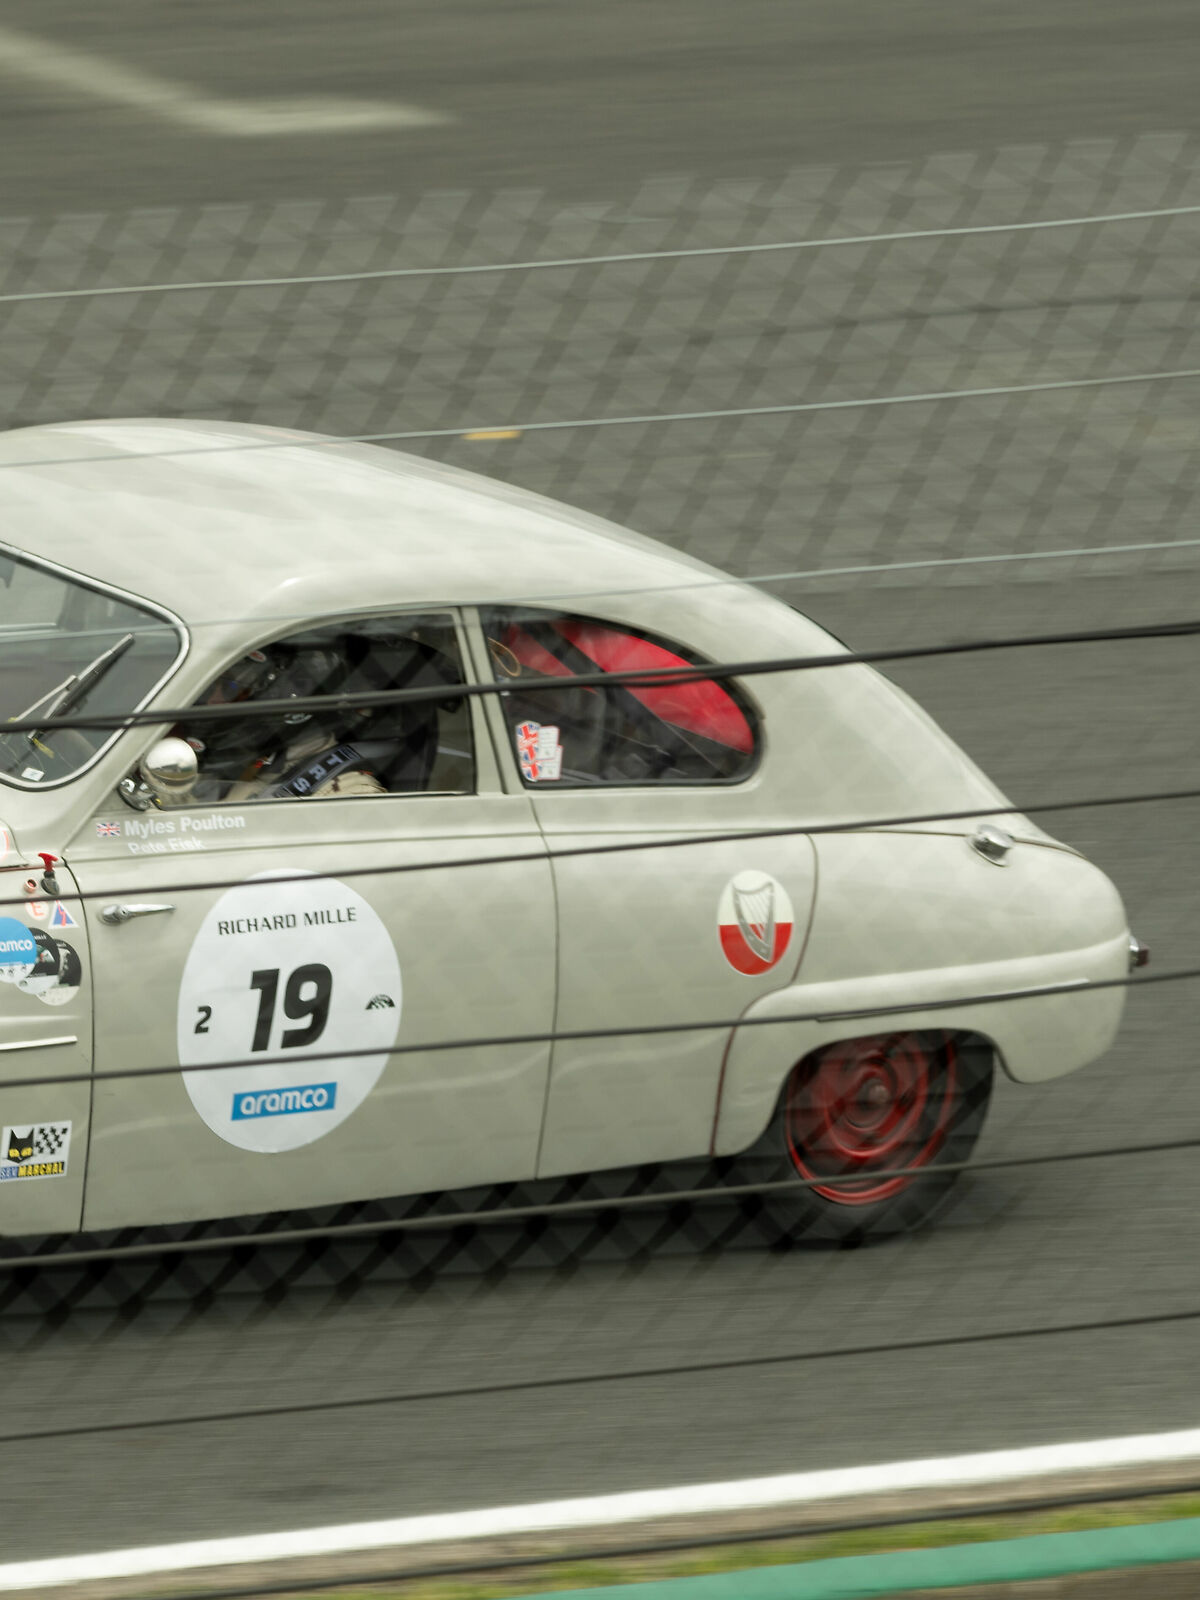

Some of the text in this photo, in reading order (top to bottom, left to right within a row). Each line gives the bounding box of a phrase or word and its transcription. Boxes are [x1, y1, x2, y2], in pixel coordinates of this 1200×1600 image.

[124, 814, 246, 839] Myles Poulton
[127, 841, 166, 855] Pete
[217, 907, 357, 936] RICHARD MILLE
[194, 1005, 212, 1034] 2
[249, 963, 333, 1052] 19
[240, 1088, 329, 1116] aramco
